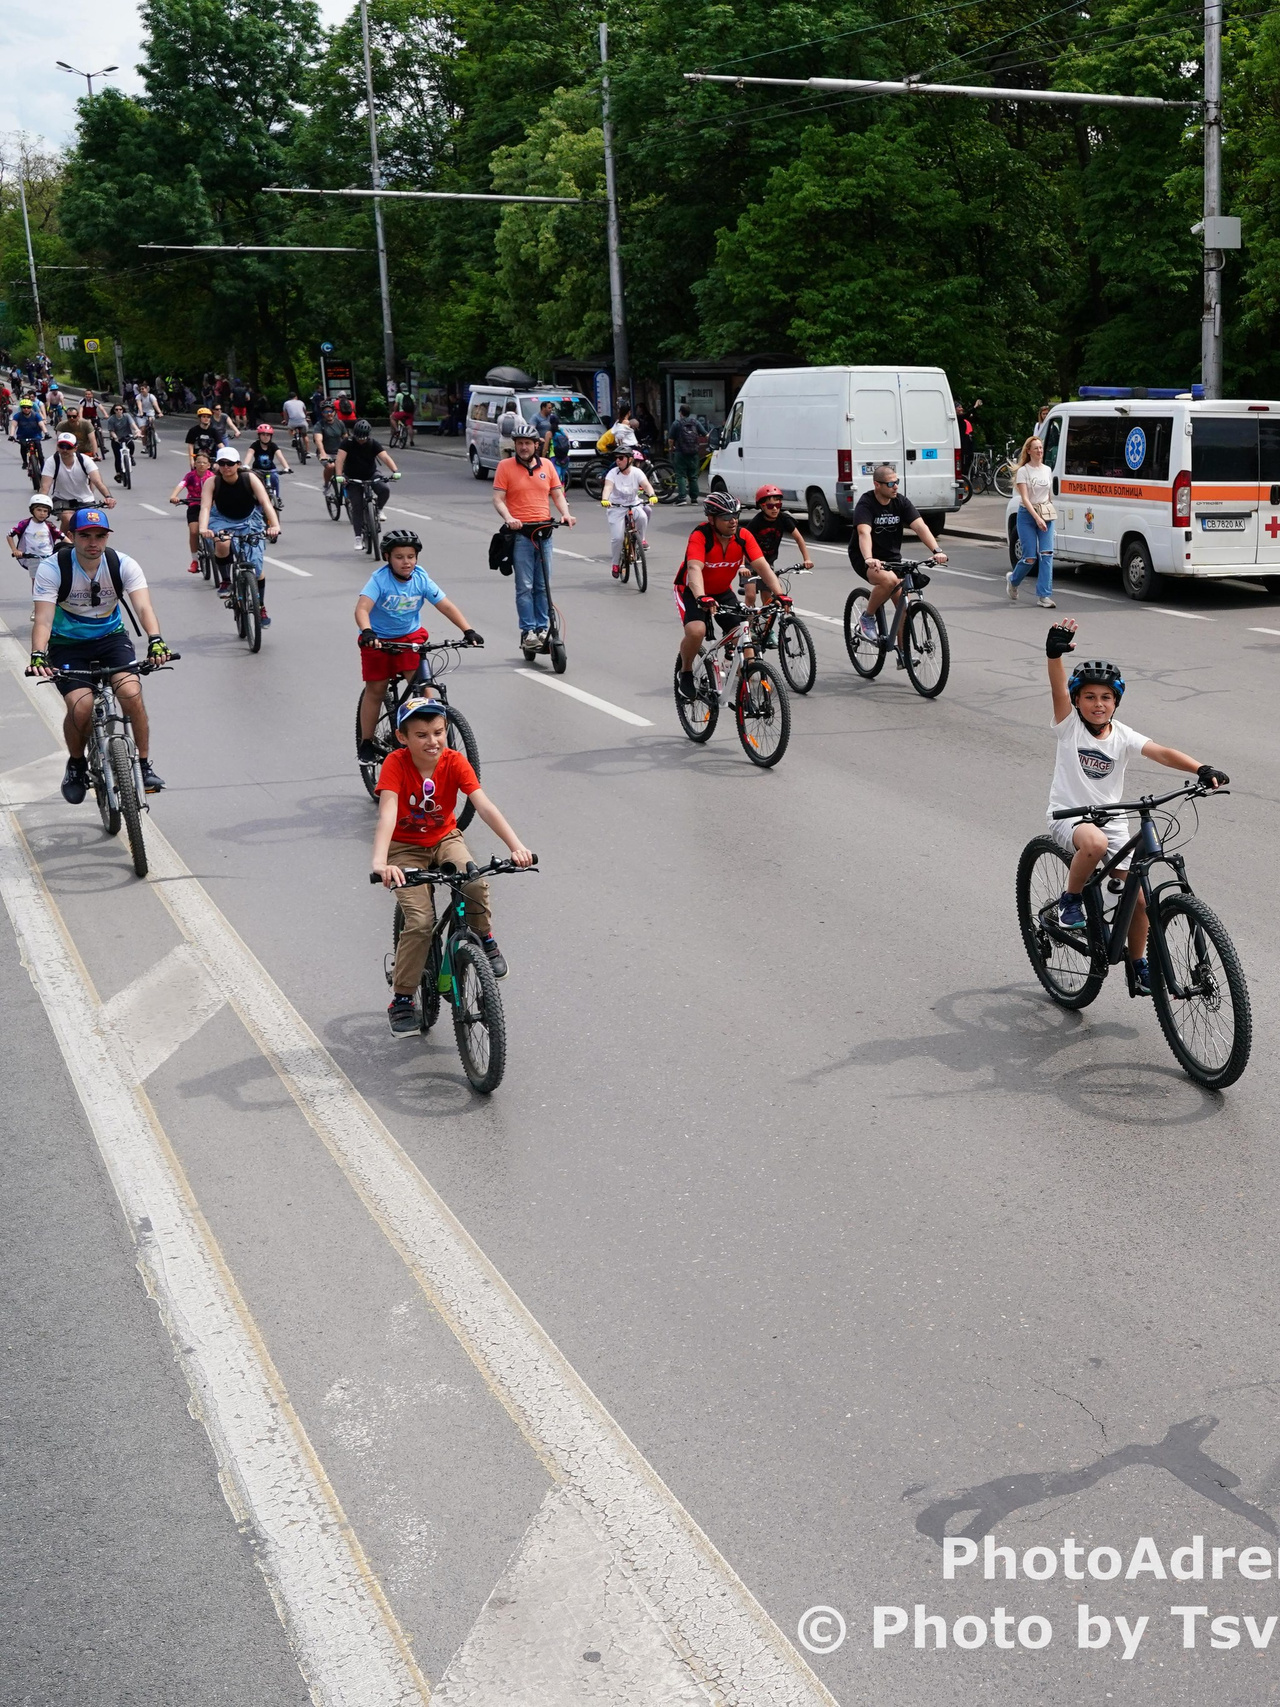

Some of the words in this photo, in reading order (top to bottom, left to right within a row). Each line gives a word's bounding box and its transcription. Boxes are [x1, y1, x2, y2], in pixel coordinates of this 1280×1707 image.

[1068, 482, 1087, 492] ПЪРВА
[1087, 484, 1113, 495] ГРАДСКА
[1113, 486, 1143, 498] БОЛНИЦА
[1217, 520, 1233, 529] 7820
[1078, 754, 1111, 770] INTAGE
